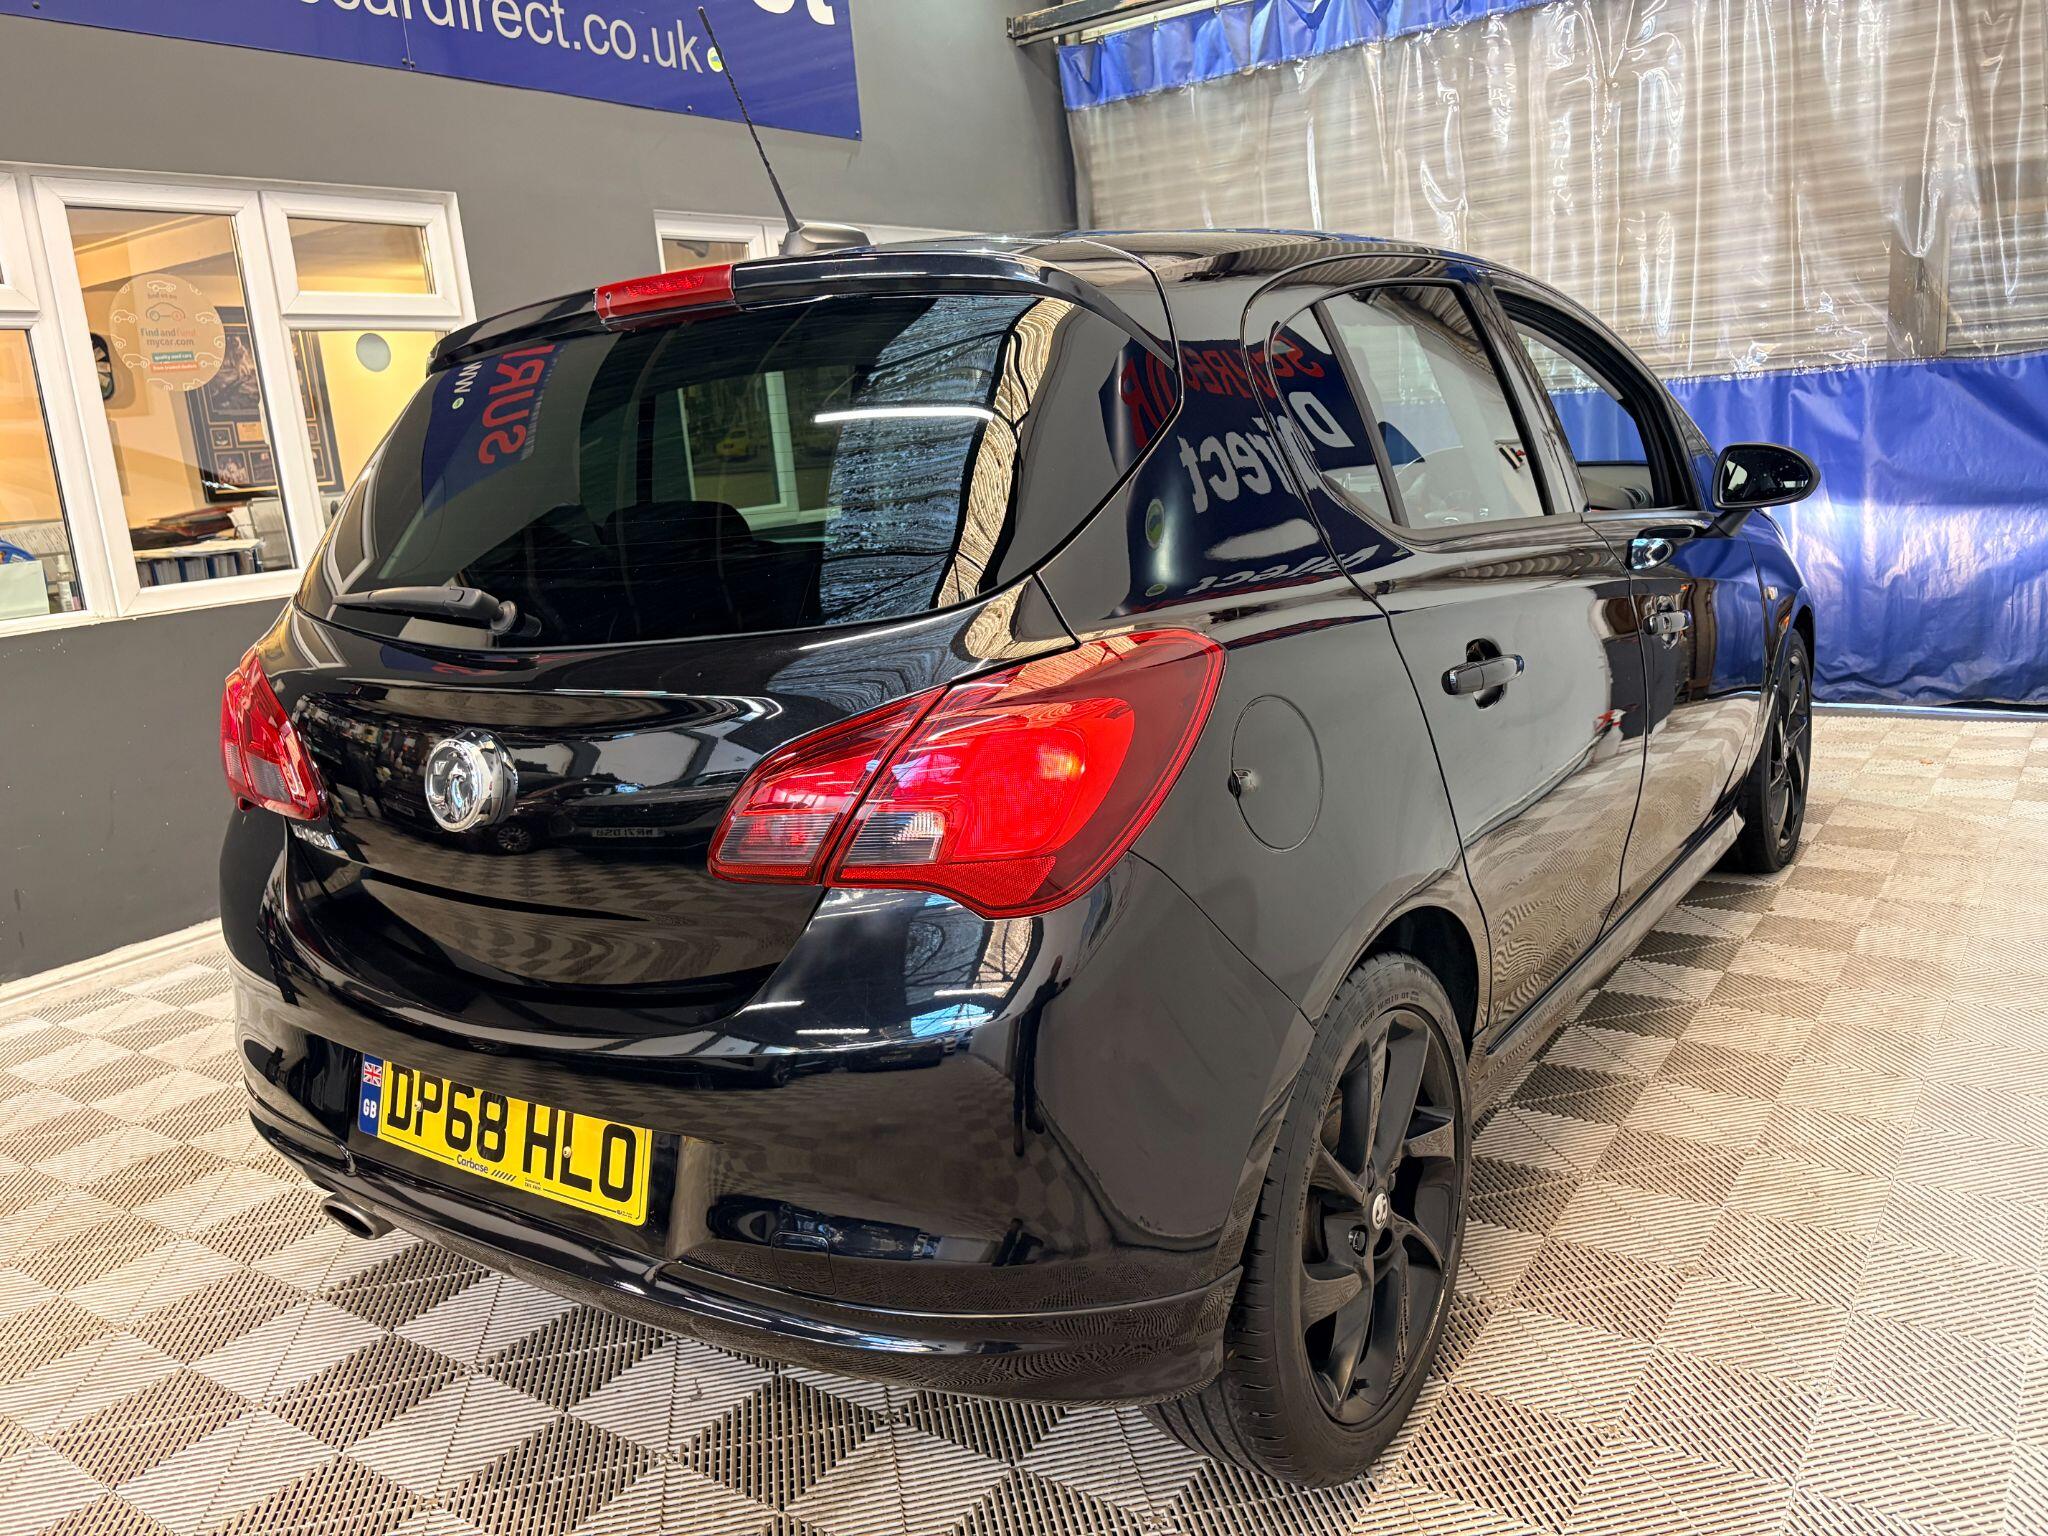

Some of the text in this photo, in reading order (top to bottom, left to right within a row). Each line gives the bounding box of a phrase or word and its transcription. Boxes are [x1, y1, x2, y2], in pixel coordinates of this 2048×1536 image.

[363, 1098, 377, 1119] GB
[387, 1061, 637, 1203] DP68 HLO
[457, 1154, 489, 1174] Carbase
